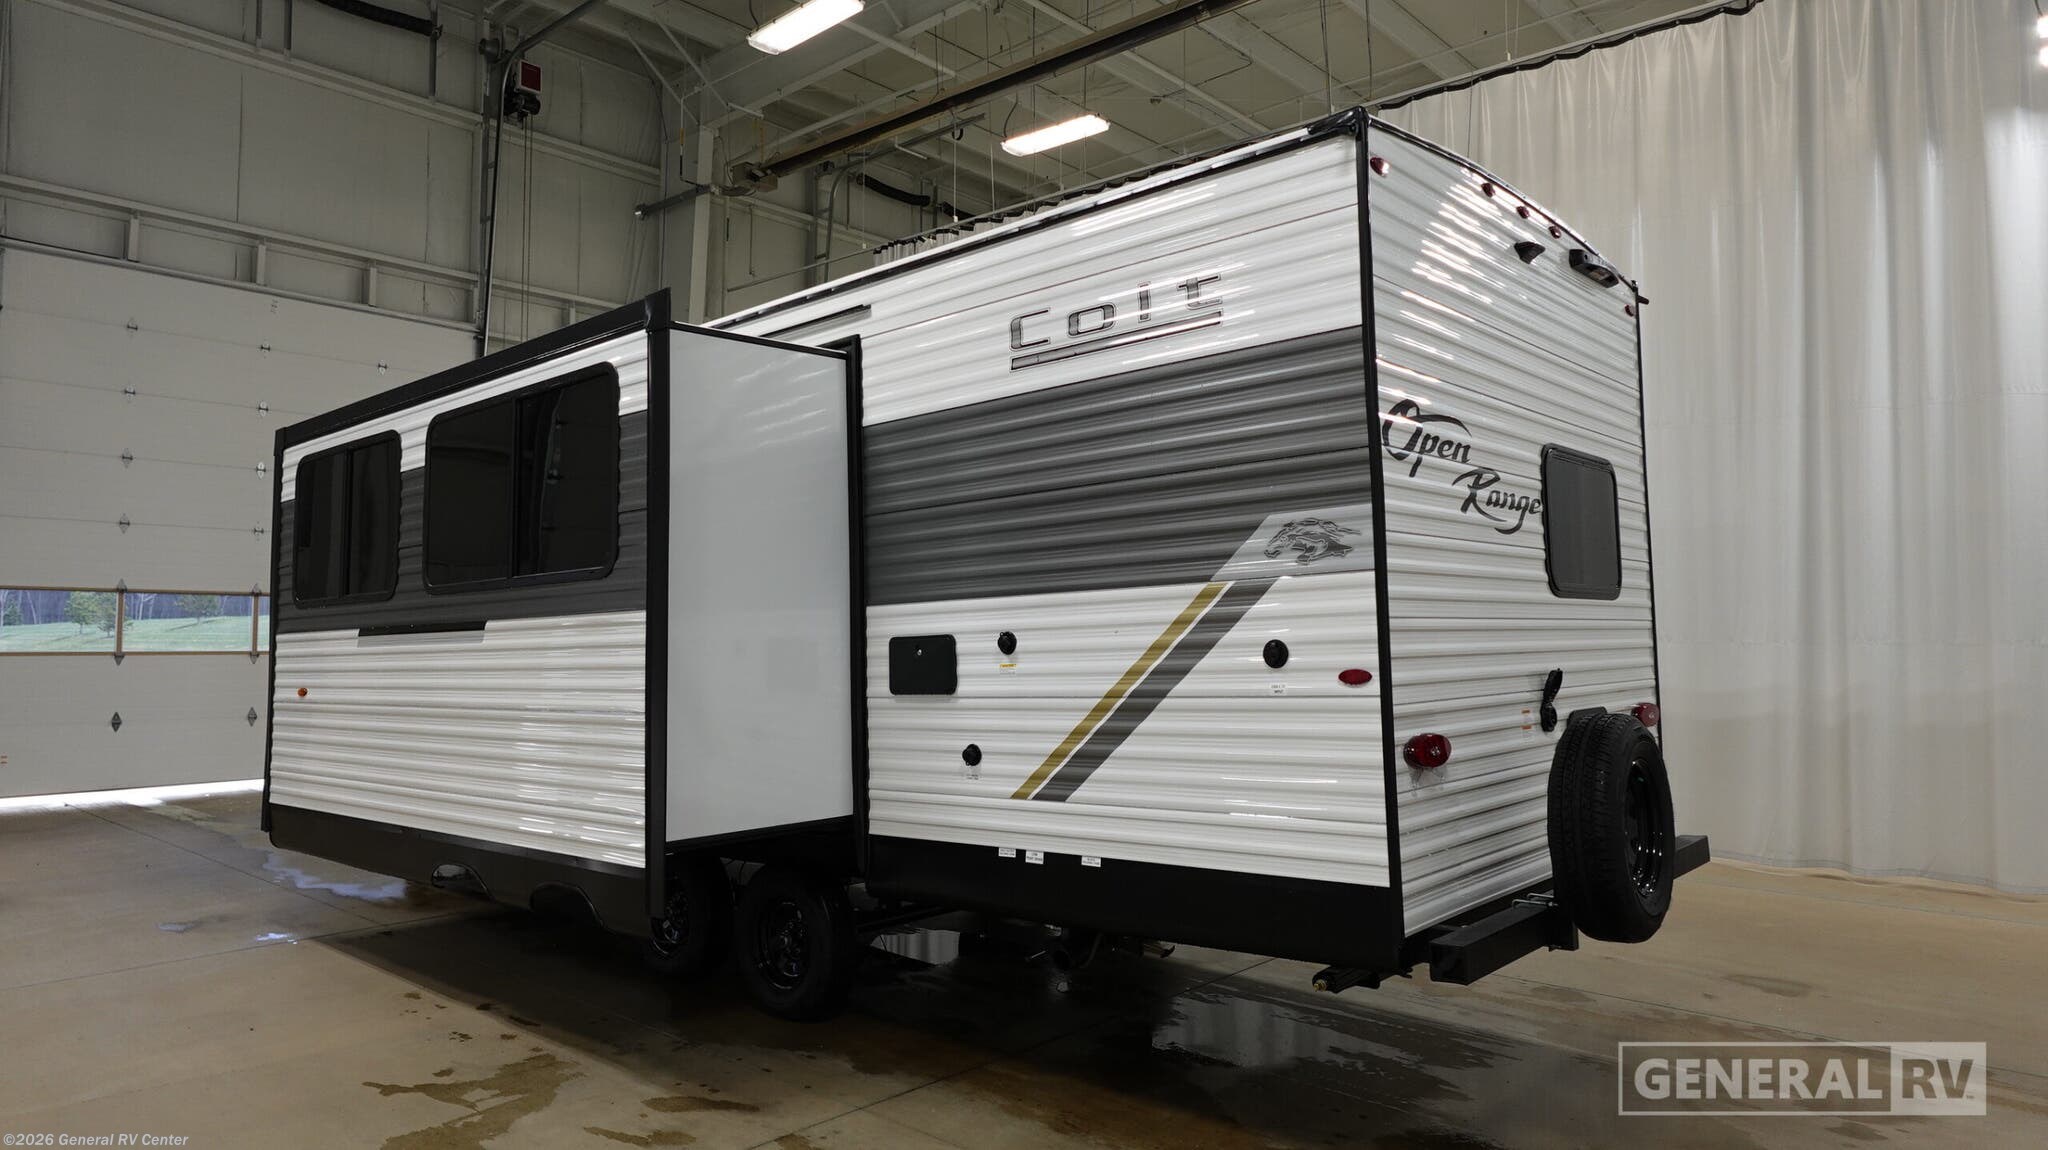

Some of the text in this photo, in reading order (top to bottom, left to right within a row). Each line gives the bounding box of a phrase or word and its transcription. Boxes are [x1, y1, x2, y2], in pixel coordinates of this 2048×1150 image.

[1009, 273, 1222, 352] Colt
[1381, 399, 1473, 478] Open
[1451, 467, 1542, 535] Range
